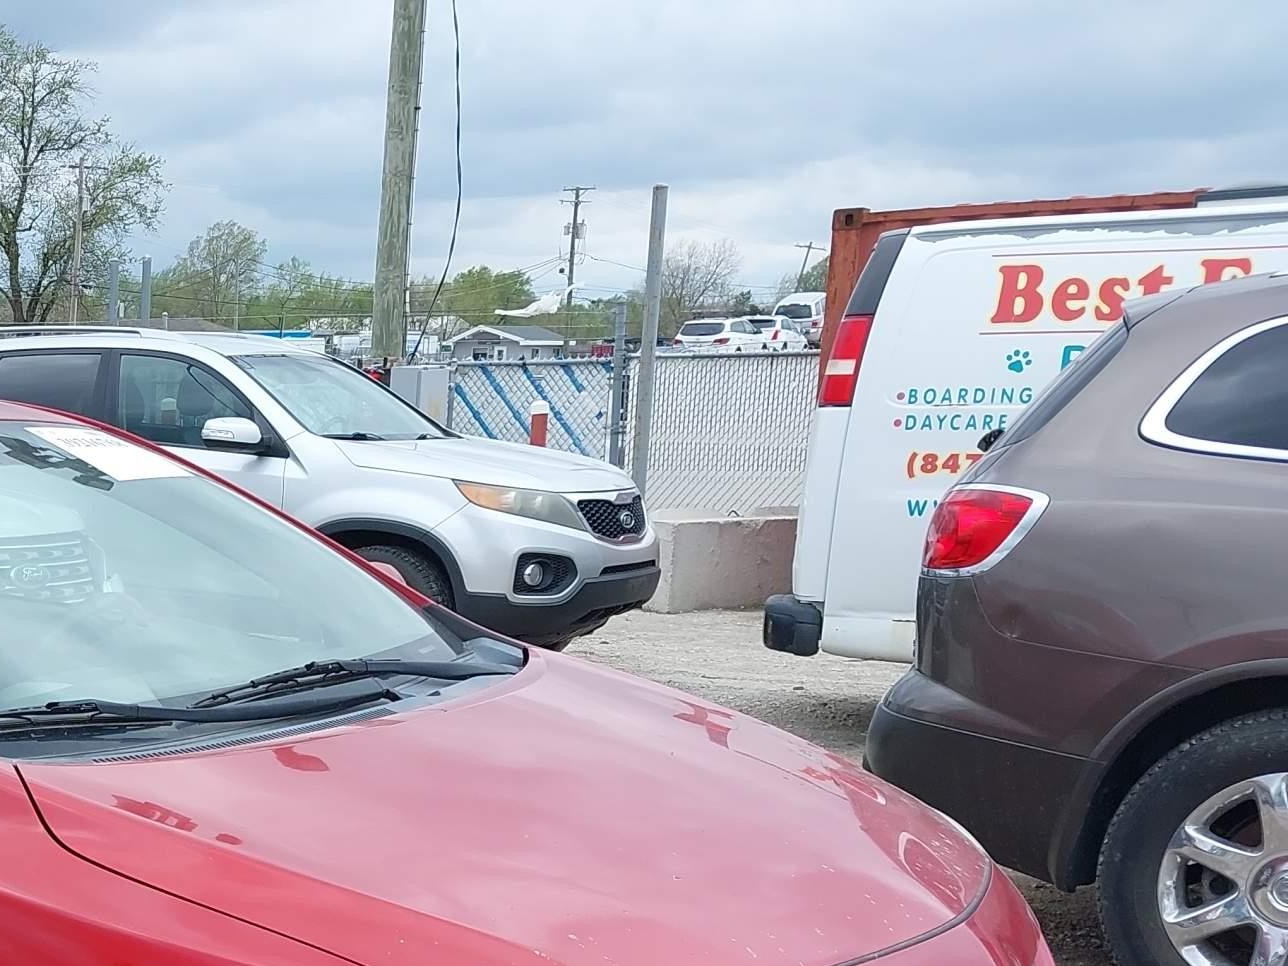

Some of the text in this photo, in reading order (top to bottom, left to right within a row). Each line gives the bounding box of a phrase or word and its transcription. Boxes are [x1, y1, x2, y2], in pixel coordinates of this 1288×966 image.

[991, 264, 1174, 323] Best
[907, 387, 1033, 405] BOARDING
[904, 414, 1008, 431] DAYCARE
